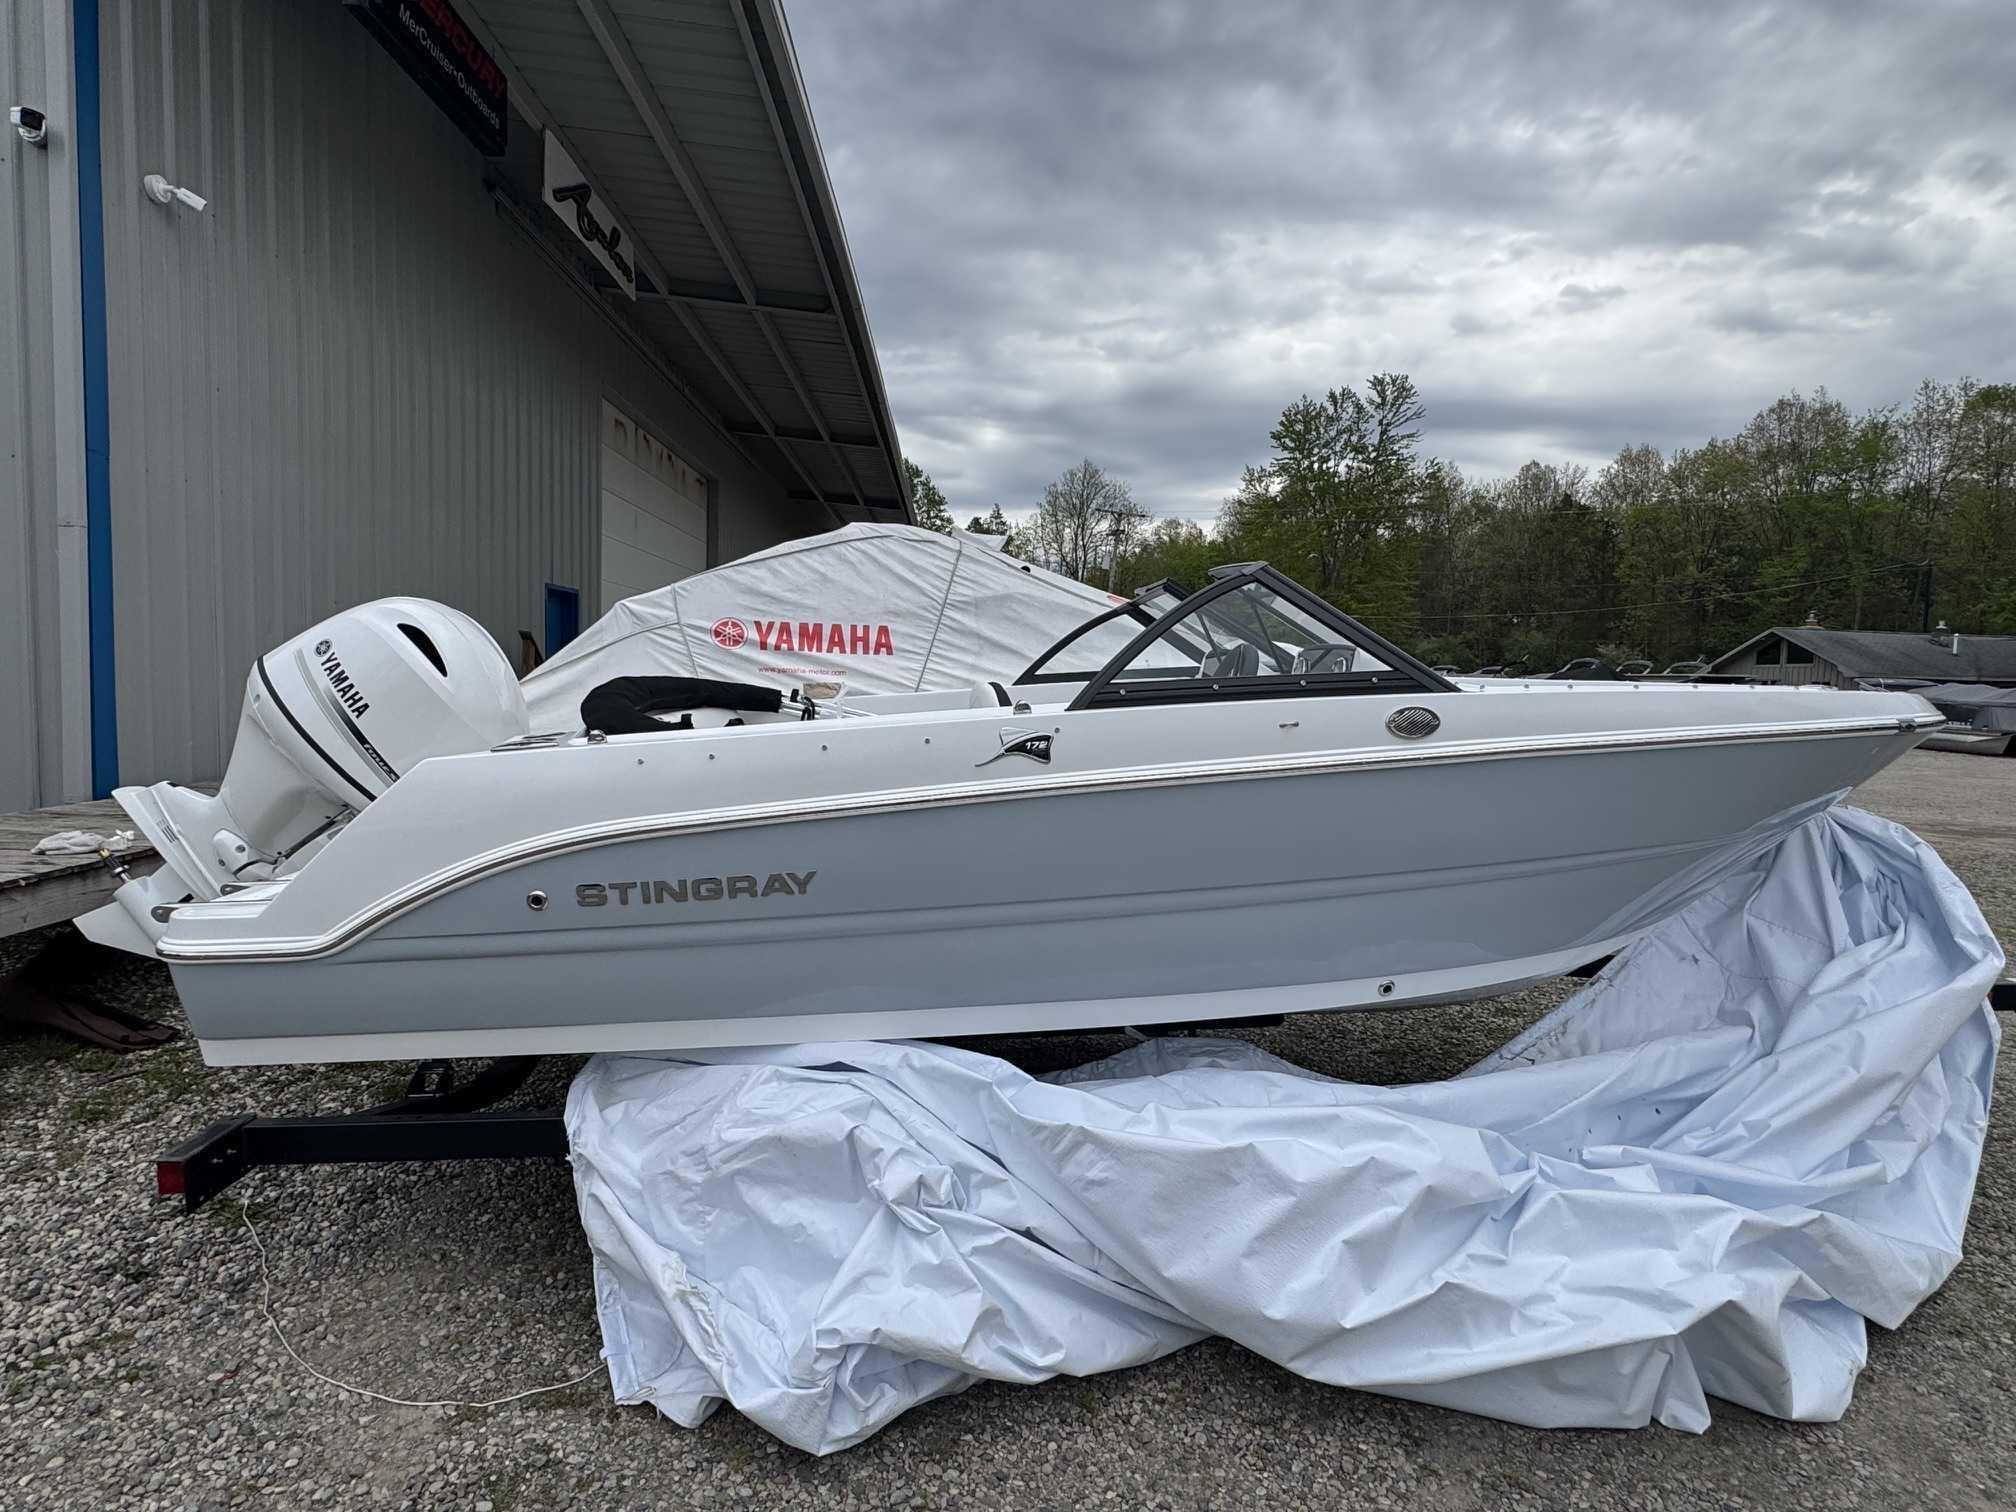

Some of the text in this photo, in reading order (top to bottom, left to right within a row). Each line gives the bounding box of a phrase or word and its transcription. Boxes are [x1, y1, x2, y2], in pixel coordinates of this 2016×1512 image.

[418, 0, 506, 98] ERCURY
[753, 620, 894, 656] YAMAHA
[320, 651, 371, 720] YAMAHA
[1025, 740, 1048, 750] 172
[575, 870, 817, 908] STINGRAY
